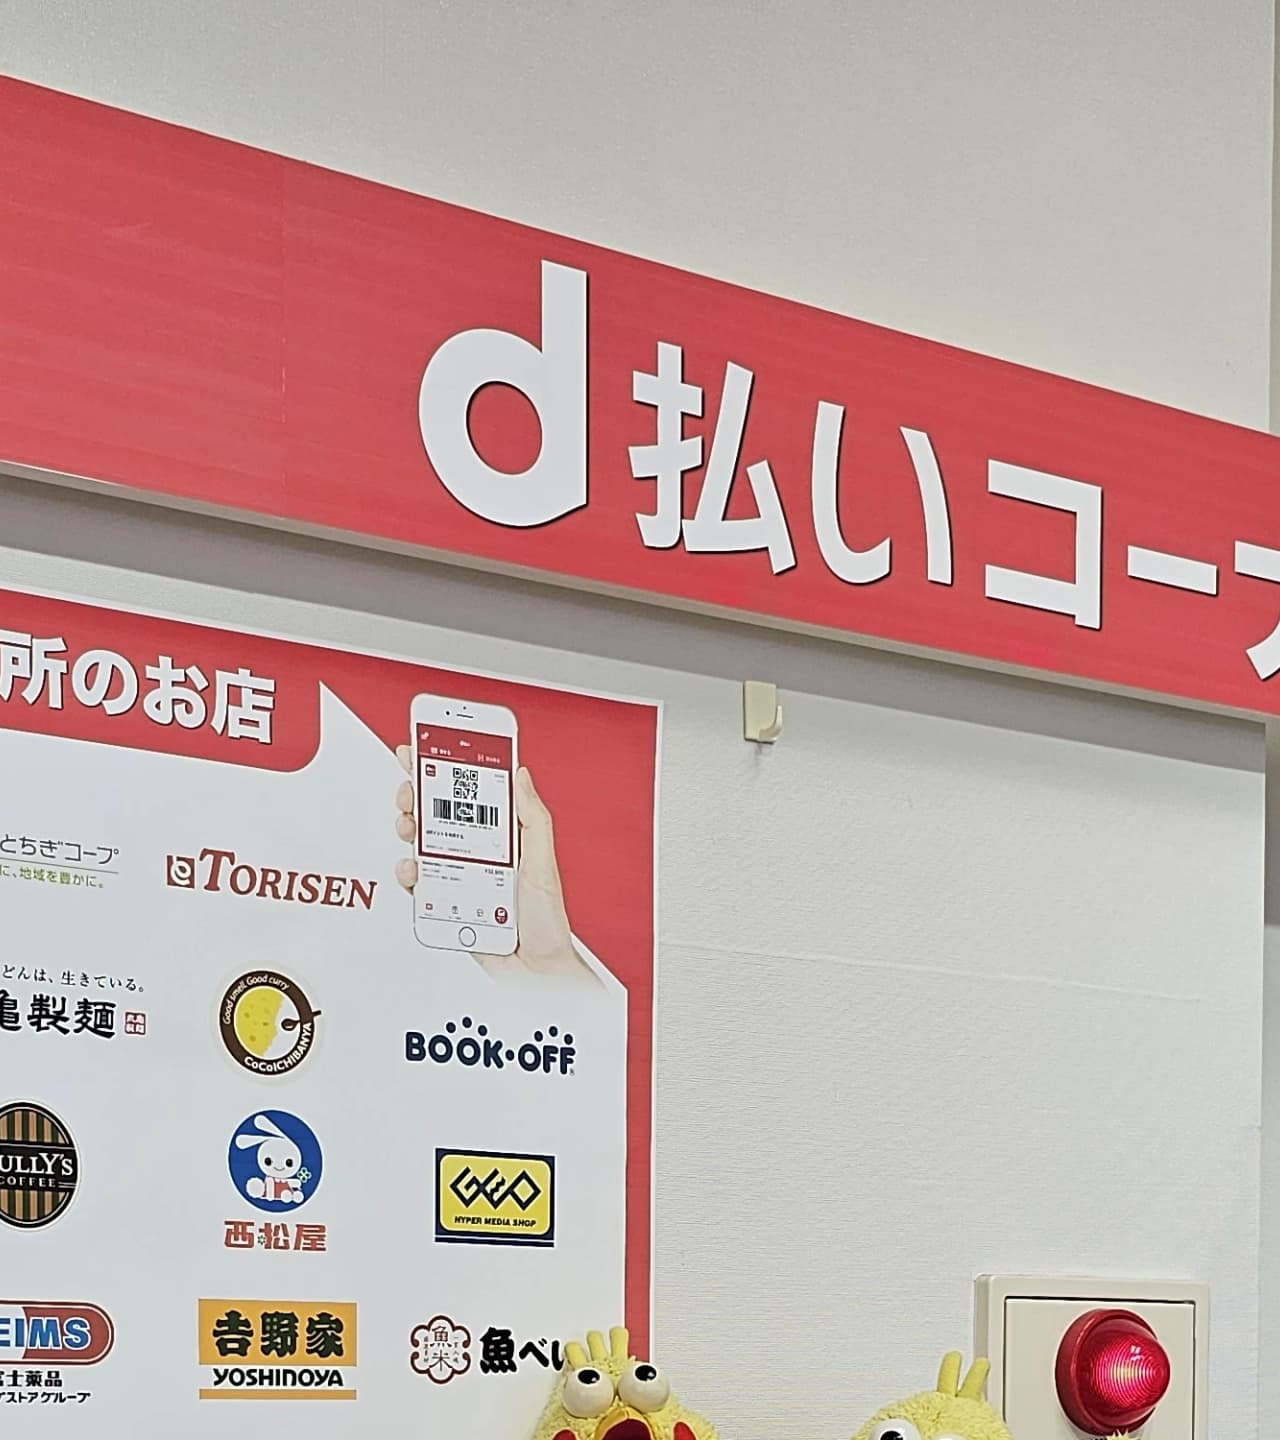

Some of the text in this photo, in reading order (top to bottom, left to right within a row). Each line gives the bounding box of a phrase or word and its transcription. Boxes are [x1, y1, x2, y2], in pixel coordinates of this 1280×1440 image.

[0, 833, 120, 866] とちぎコープ
[198, 847, 379, 911] TORISEN
[268, 975, 291, 991] curry
[223, 1219, 328, 1253] 西松屋
[454, 1214, 538, 1229] HYPER MEDIA SHOP
